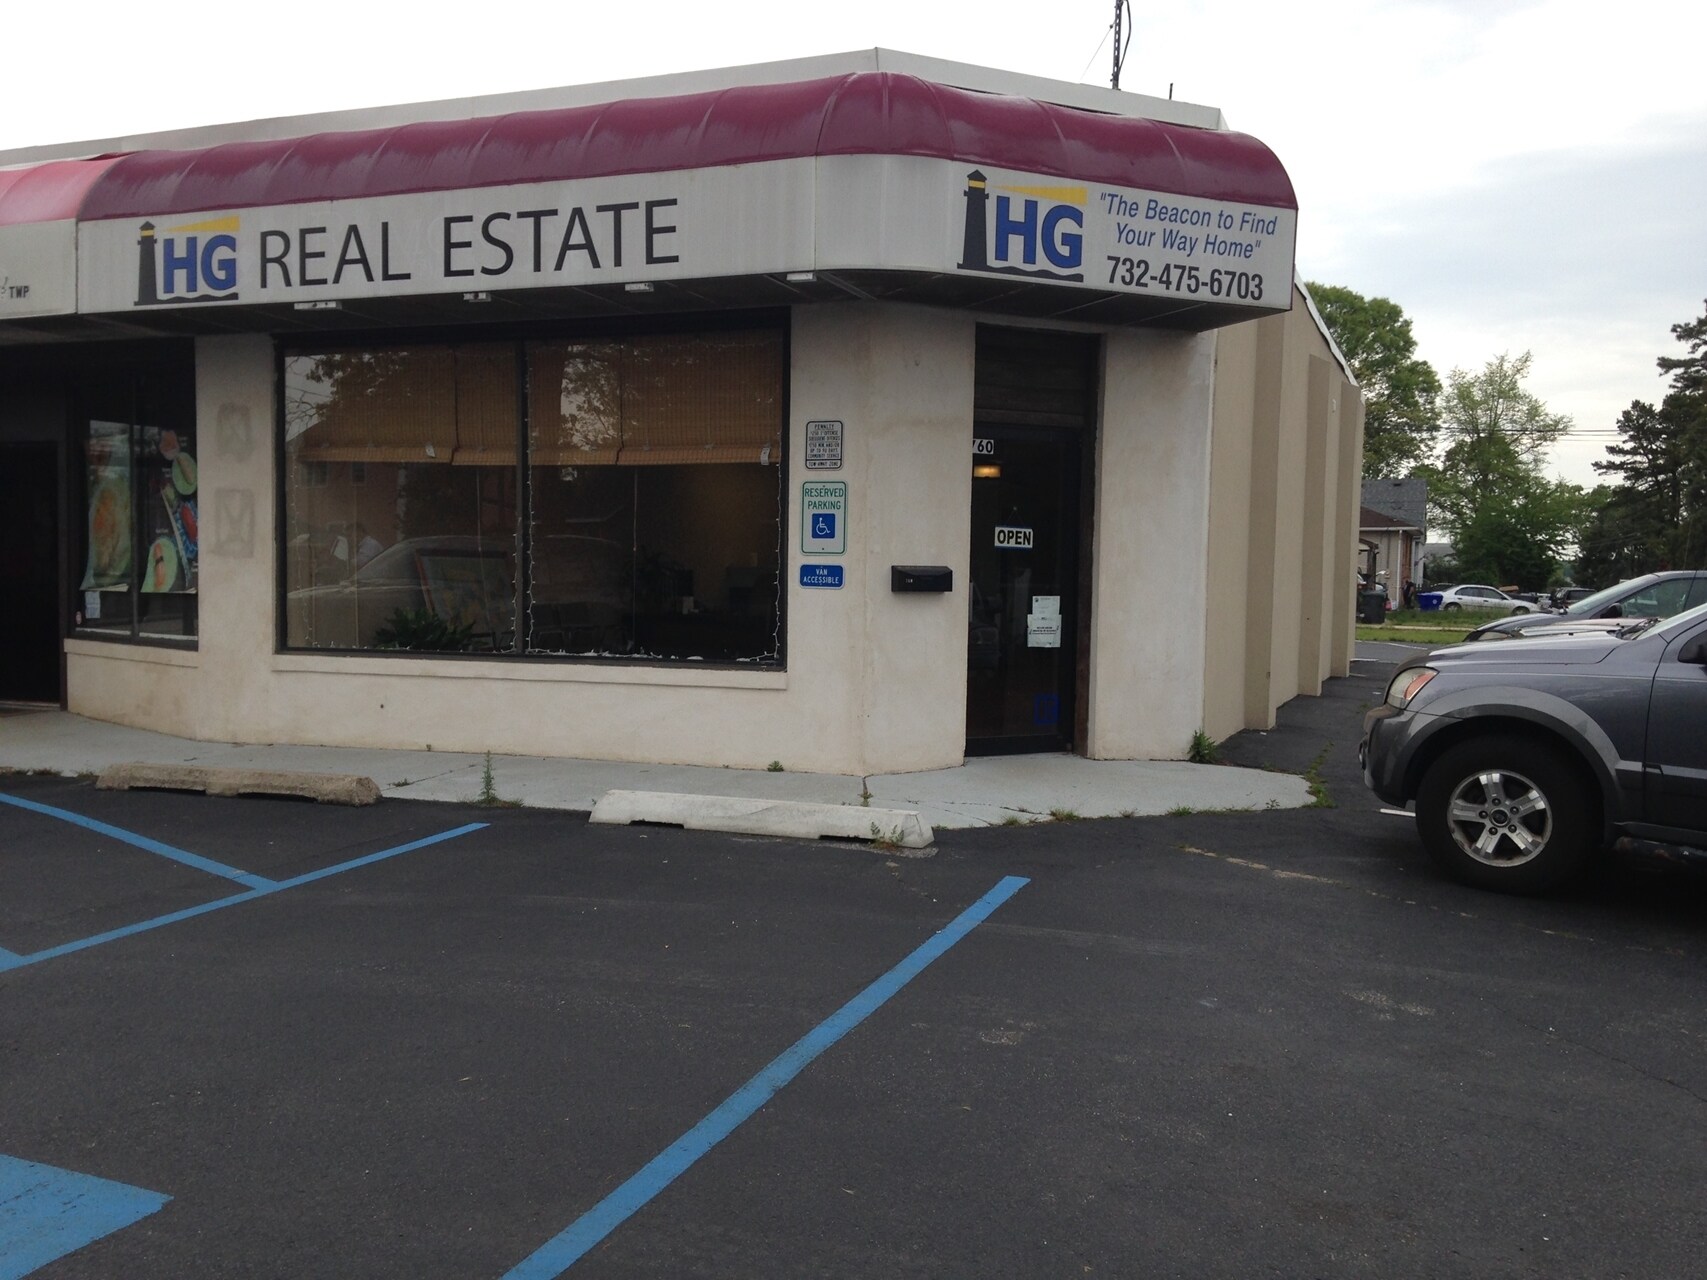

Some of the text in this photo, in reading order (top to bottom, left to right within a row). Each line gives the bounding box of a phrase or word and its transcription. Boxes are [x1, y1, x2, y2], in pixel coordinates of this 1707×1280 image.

[1145, 199, 1212, 227] Beacon
[1217, 209, 1234, 230] to
[1239, 213, 1278, 236] Find
[259, 221, 412, 289] REAL
[442, 197, 680, 278] ESTATE
[1116, 222, 1156, 248] Your
[1161, 228, 1199, 258] Way
[1106, 255, 1264, 301] 732-475-6703
[804, 487, 844, 498] RESERVED
[807, 500, 841, 510] PARKING
[996, 529, 1032, 546] OPEN
[803, 576, 839, 584] ACCESSIBLE
[815, 568, 828, 576] VAN
